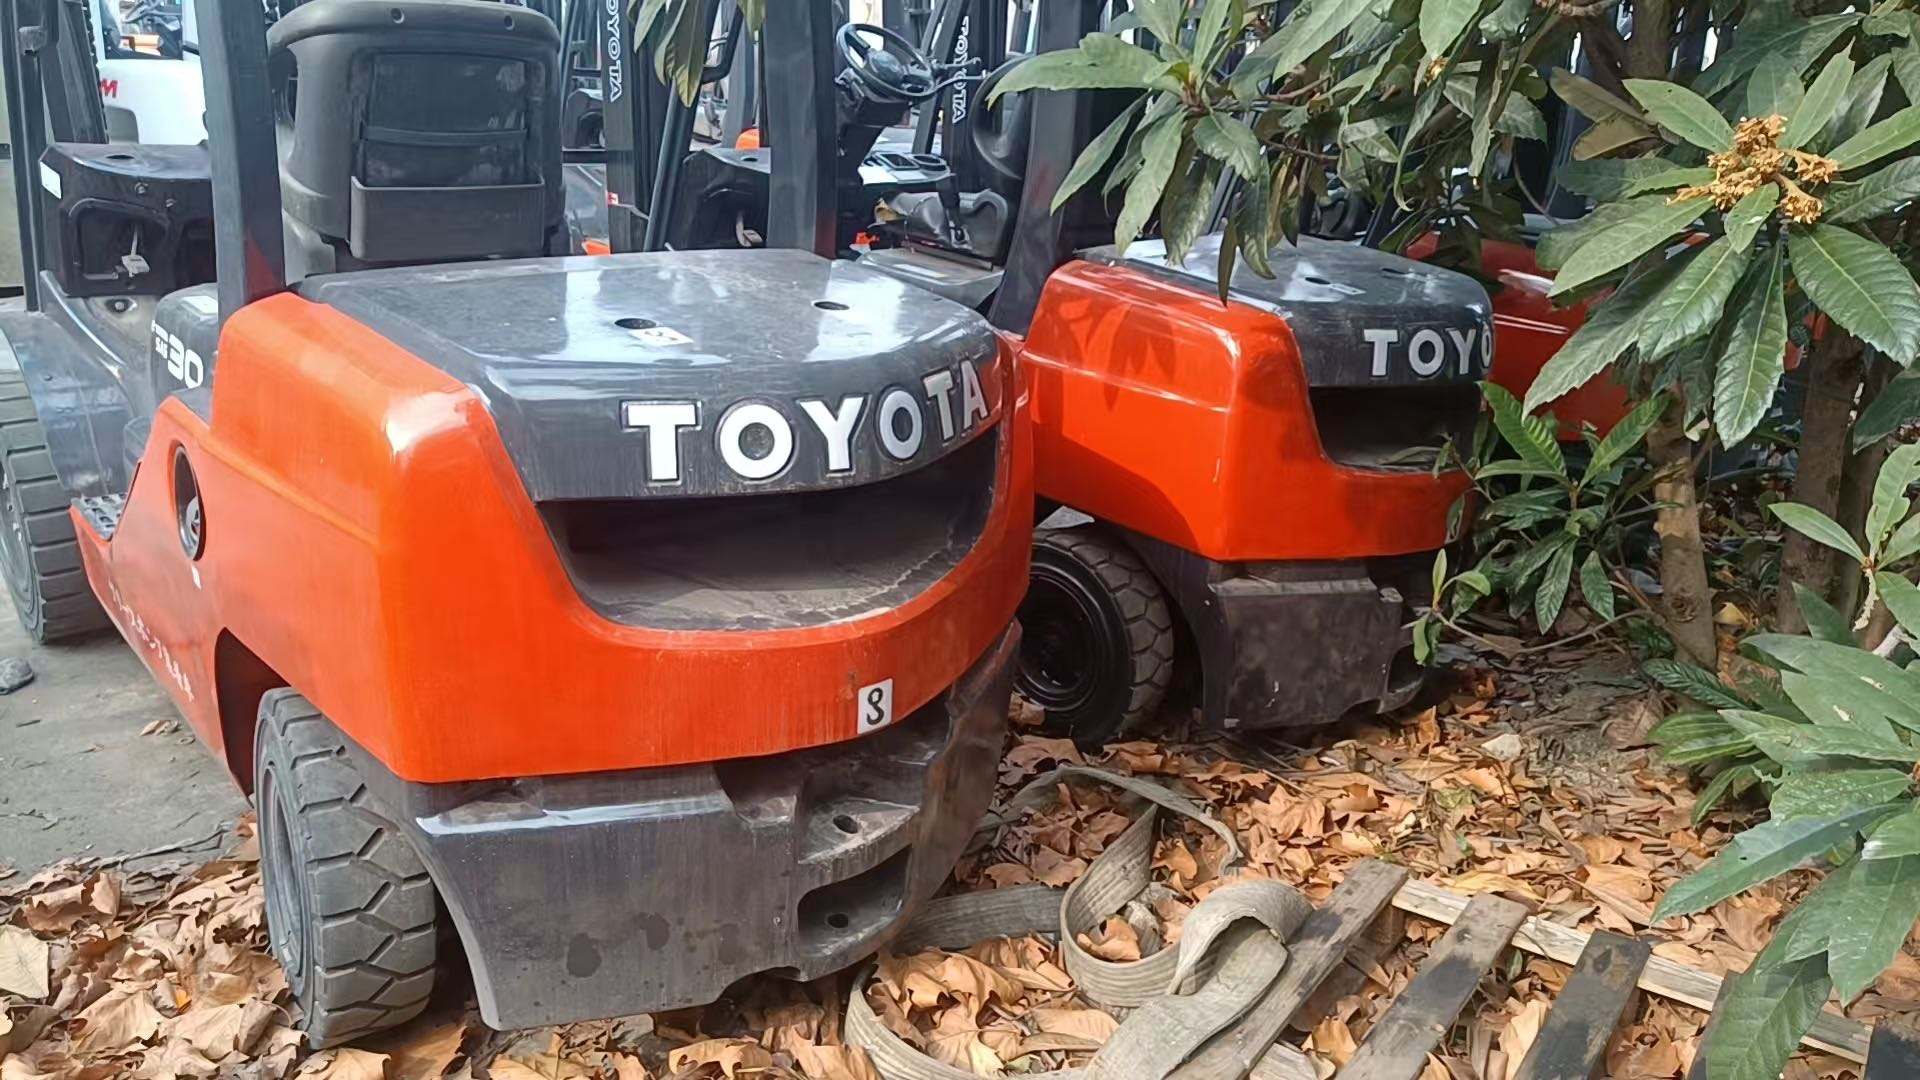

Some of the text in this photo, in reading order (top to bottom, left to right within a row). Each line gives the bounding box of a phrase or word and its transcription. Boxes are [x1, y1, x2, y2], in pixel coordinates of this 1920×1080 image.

[168, 333, 204, 388] 30
[1363, 322, 1492, 376] TOYO
[625, 360, 989, 482] TOYOTA
